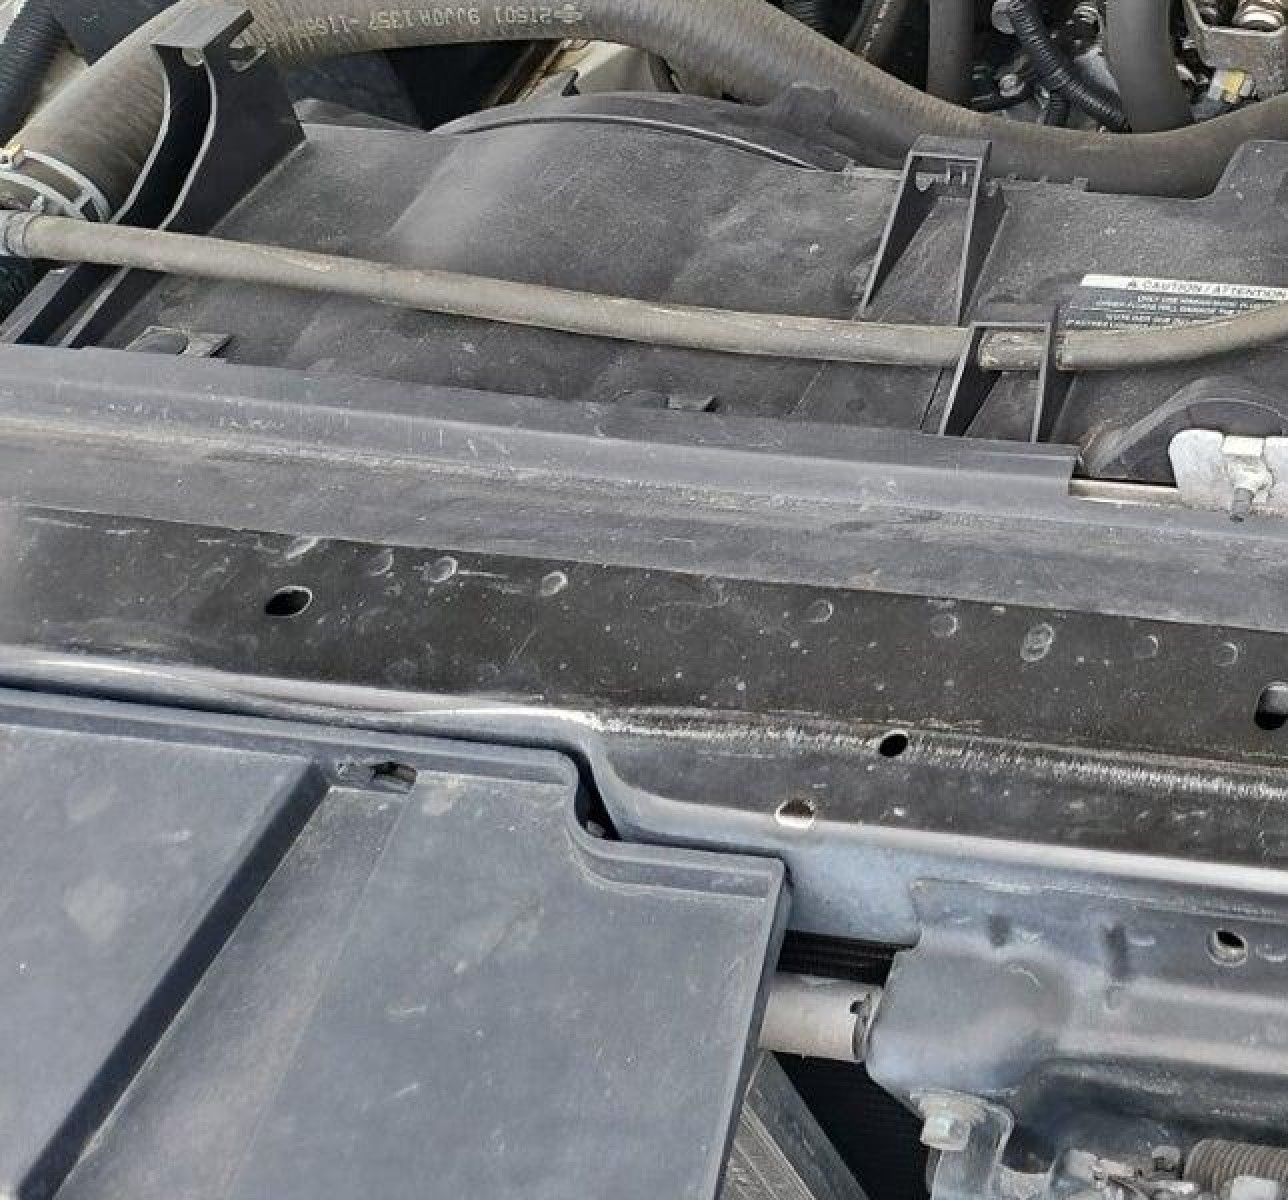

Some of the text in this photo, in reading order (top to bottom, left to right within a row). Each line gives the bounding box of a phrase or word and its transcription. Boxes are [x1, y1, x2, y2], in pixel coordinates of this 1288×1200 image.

[493, 4, 552, 25] 21501
[1143, 279, 1203, 293] CAUTION
[1213, 285, 1287, 299] ATTENTION
